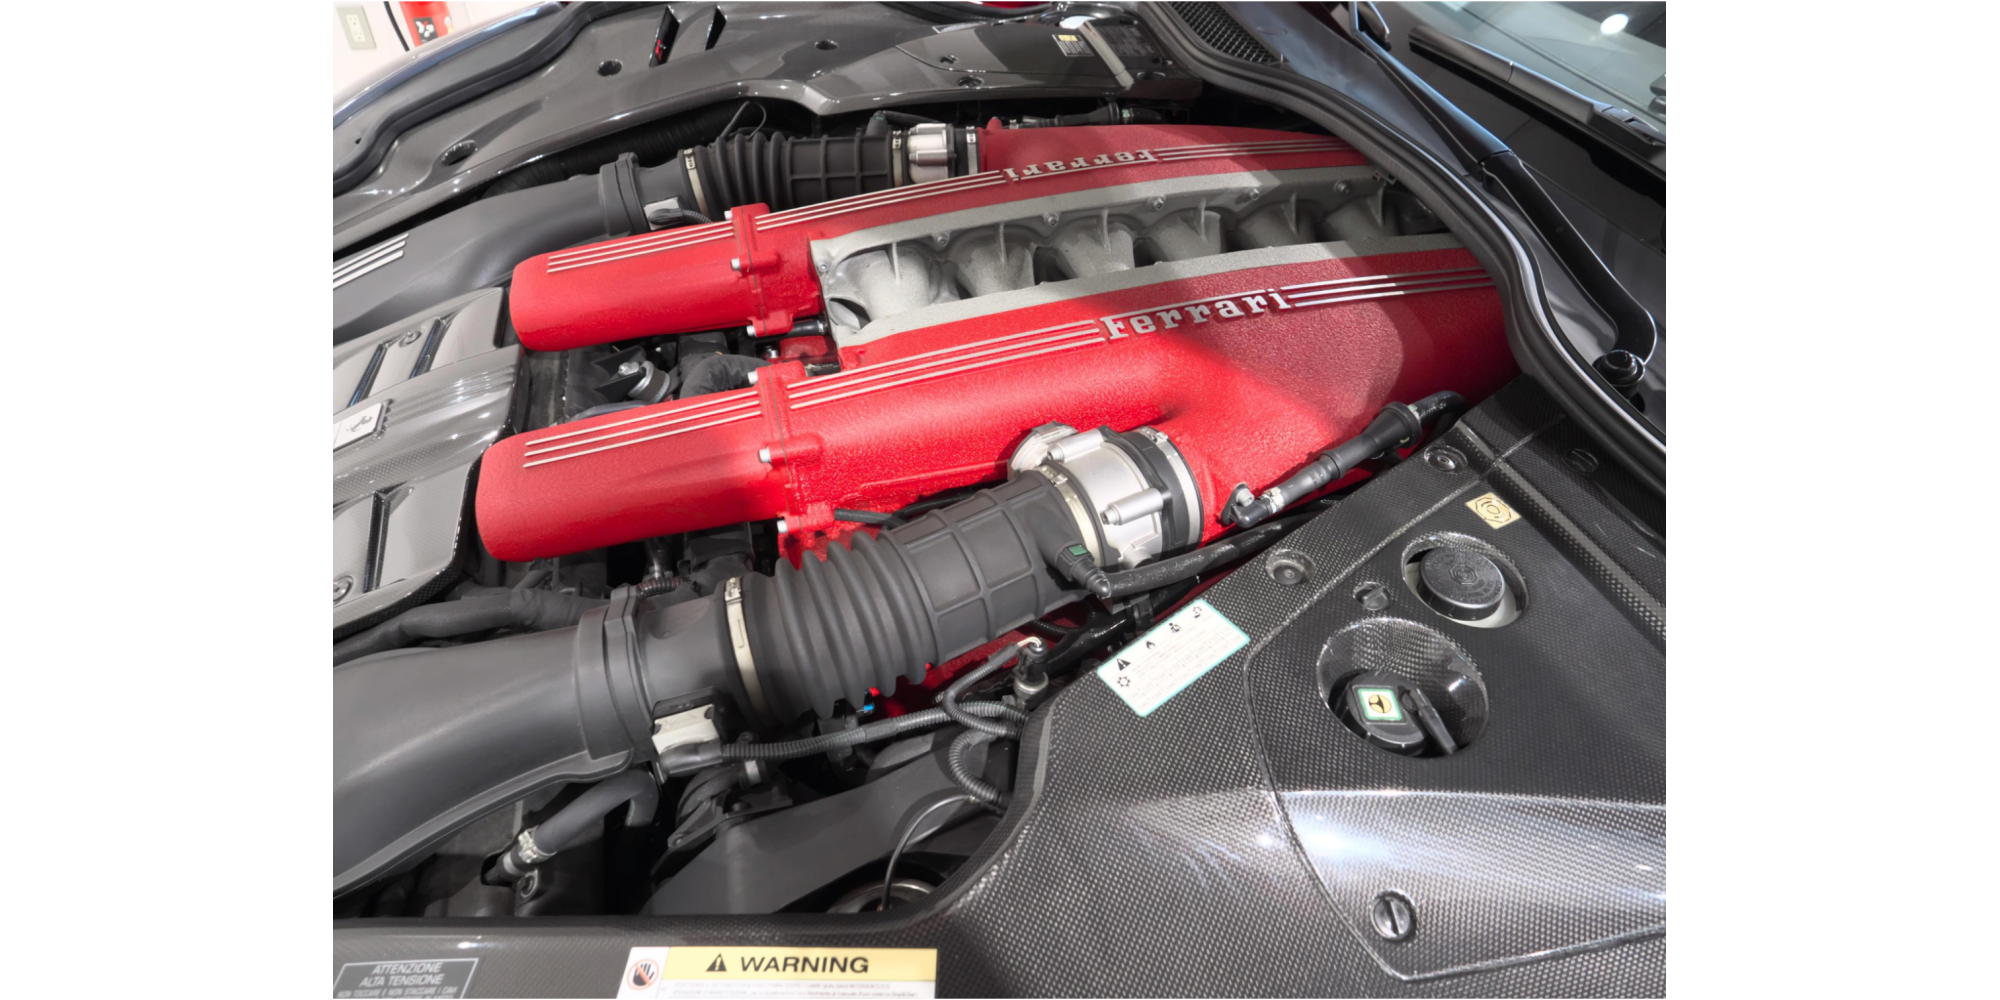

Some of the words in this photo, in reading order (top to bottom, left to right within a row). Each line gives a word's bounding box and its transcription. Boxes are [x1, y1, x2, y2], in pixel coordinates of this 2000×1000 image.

[1003, 149, 1158, 181] Ferrari
[1100, 289, 1291, 340] Ferrari
[371, 962, 444, 975] ATTENZIONE
[741, 956, 869, 973] WARNING
[359, 976, 385, 987] ALTA
[387, 974, 445, 986] TENSIONE
